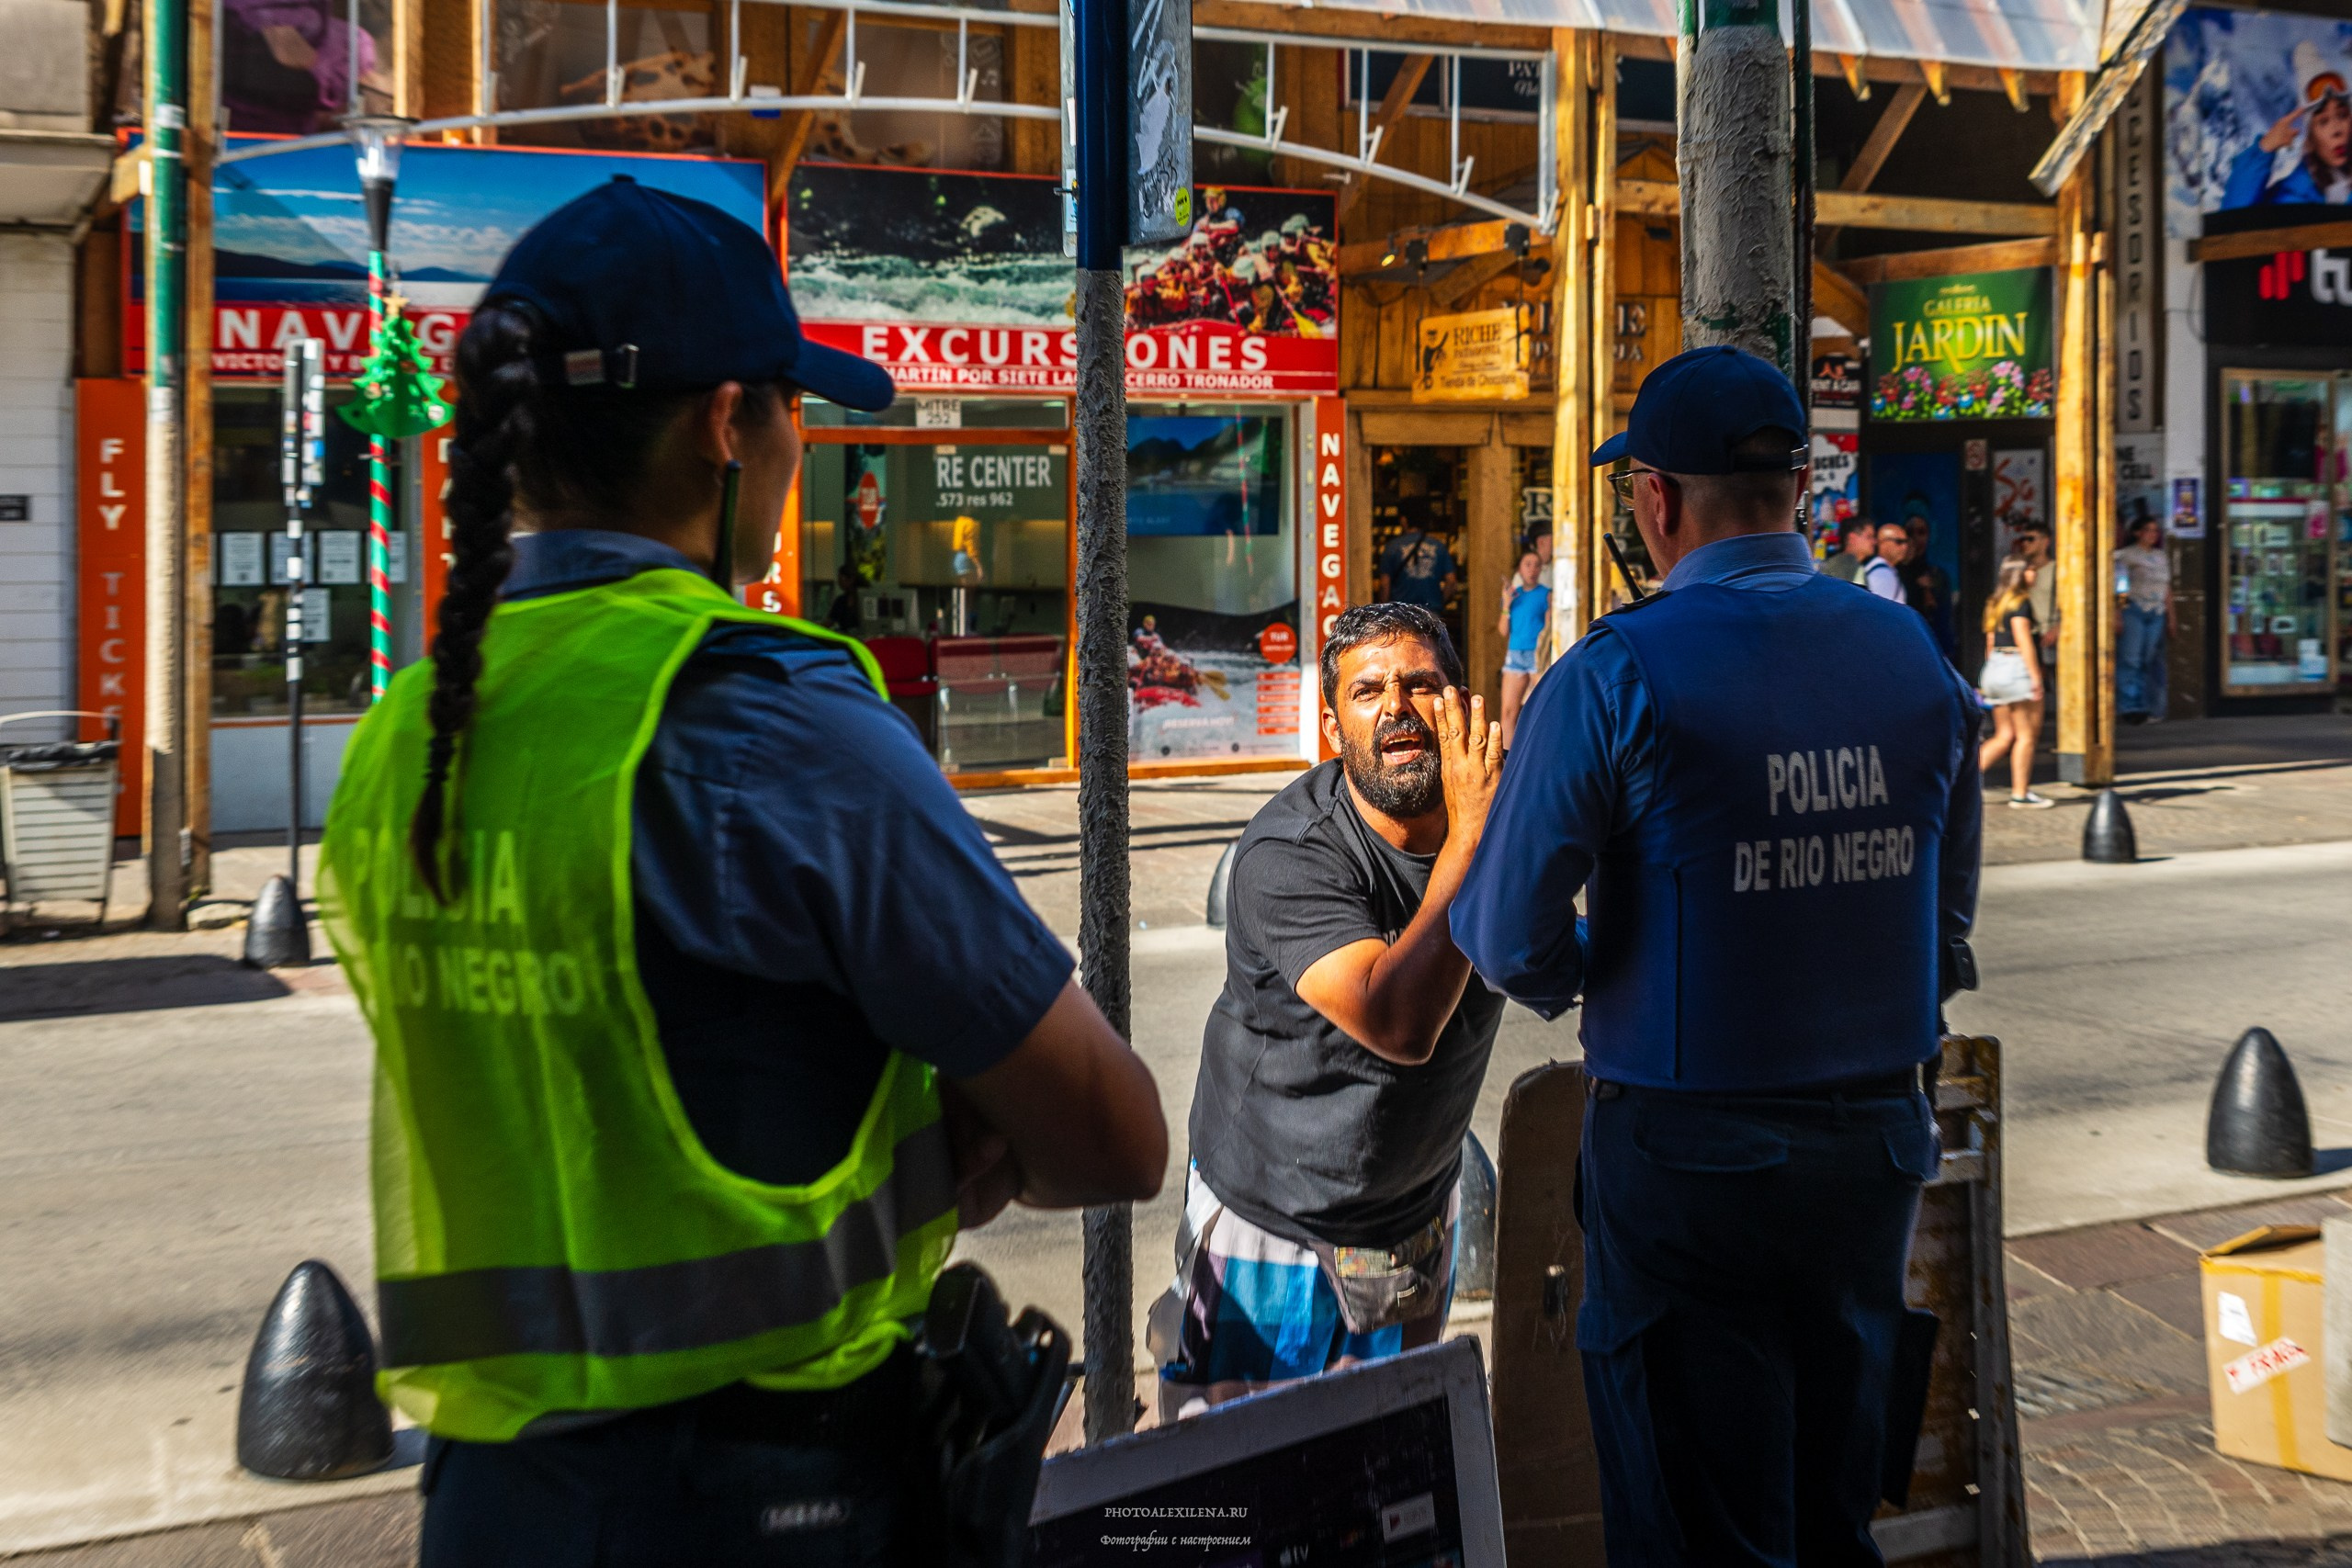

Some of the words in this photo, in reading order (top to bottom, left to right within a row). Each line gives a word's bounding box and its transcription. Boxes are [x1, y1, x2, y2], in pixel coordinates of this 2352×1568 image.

[1923, 295, 1992, 318] GALERIA
[219, 308, 457, 353] NAVG
[862, 326, 1268, 371] EXCURSONES
[1453, 323, 1502, 345] RICHE
[1893, 311, 2028, 374] JARDIN
[957, 369, 994, 384] POR
[998, 370, 1048, 385] SIETE
[1125, 372, 1181, 388] CERRO
[1186, 374, 1274, 389] TRONADOR
[918, 398, 961, 412] MITRE
[927, 413, 951, 426] 252
[98, 438, 127, 531] FLY
[935, 456, 963, 489] RE
[969, 455, 1052, 488] CENTER
[989, 491, 1014, 506] 962
[1767, 745, 1890, 816] POLICIA
[1734, 841, 1772, 893] DE
[1780, 835, 1826, 889] RIO
[1834, 825, 1915, 885] NEGRO
[435, 944, 586, 1016] NEGRO
